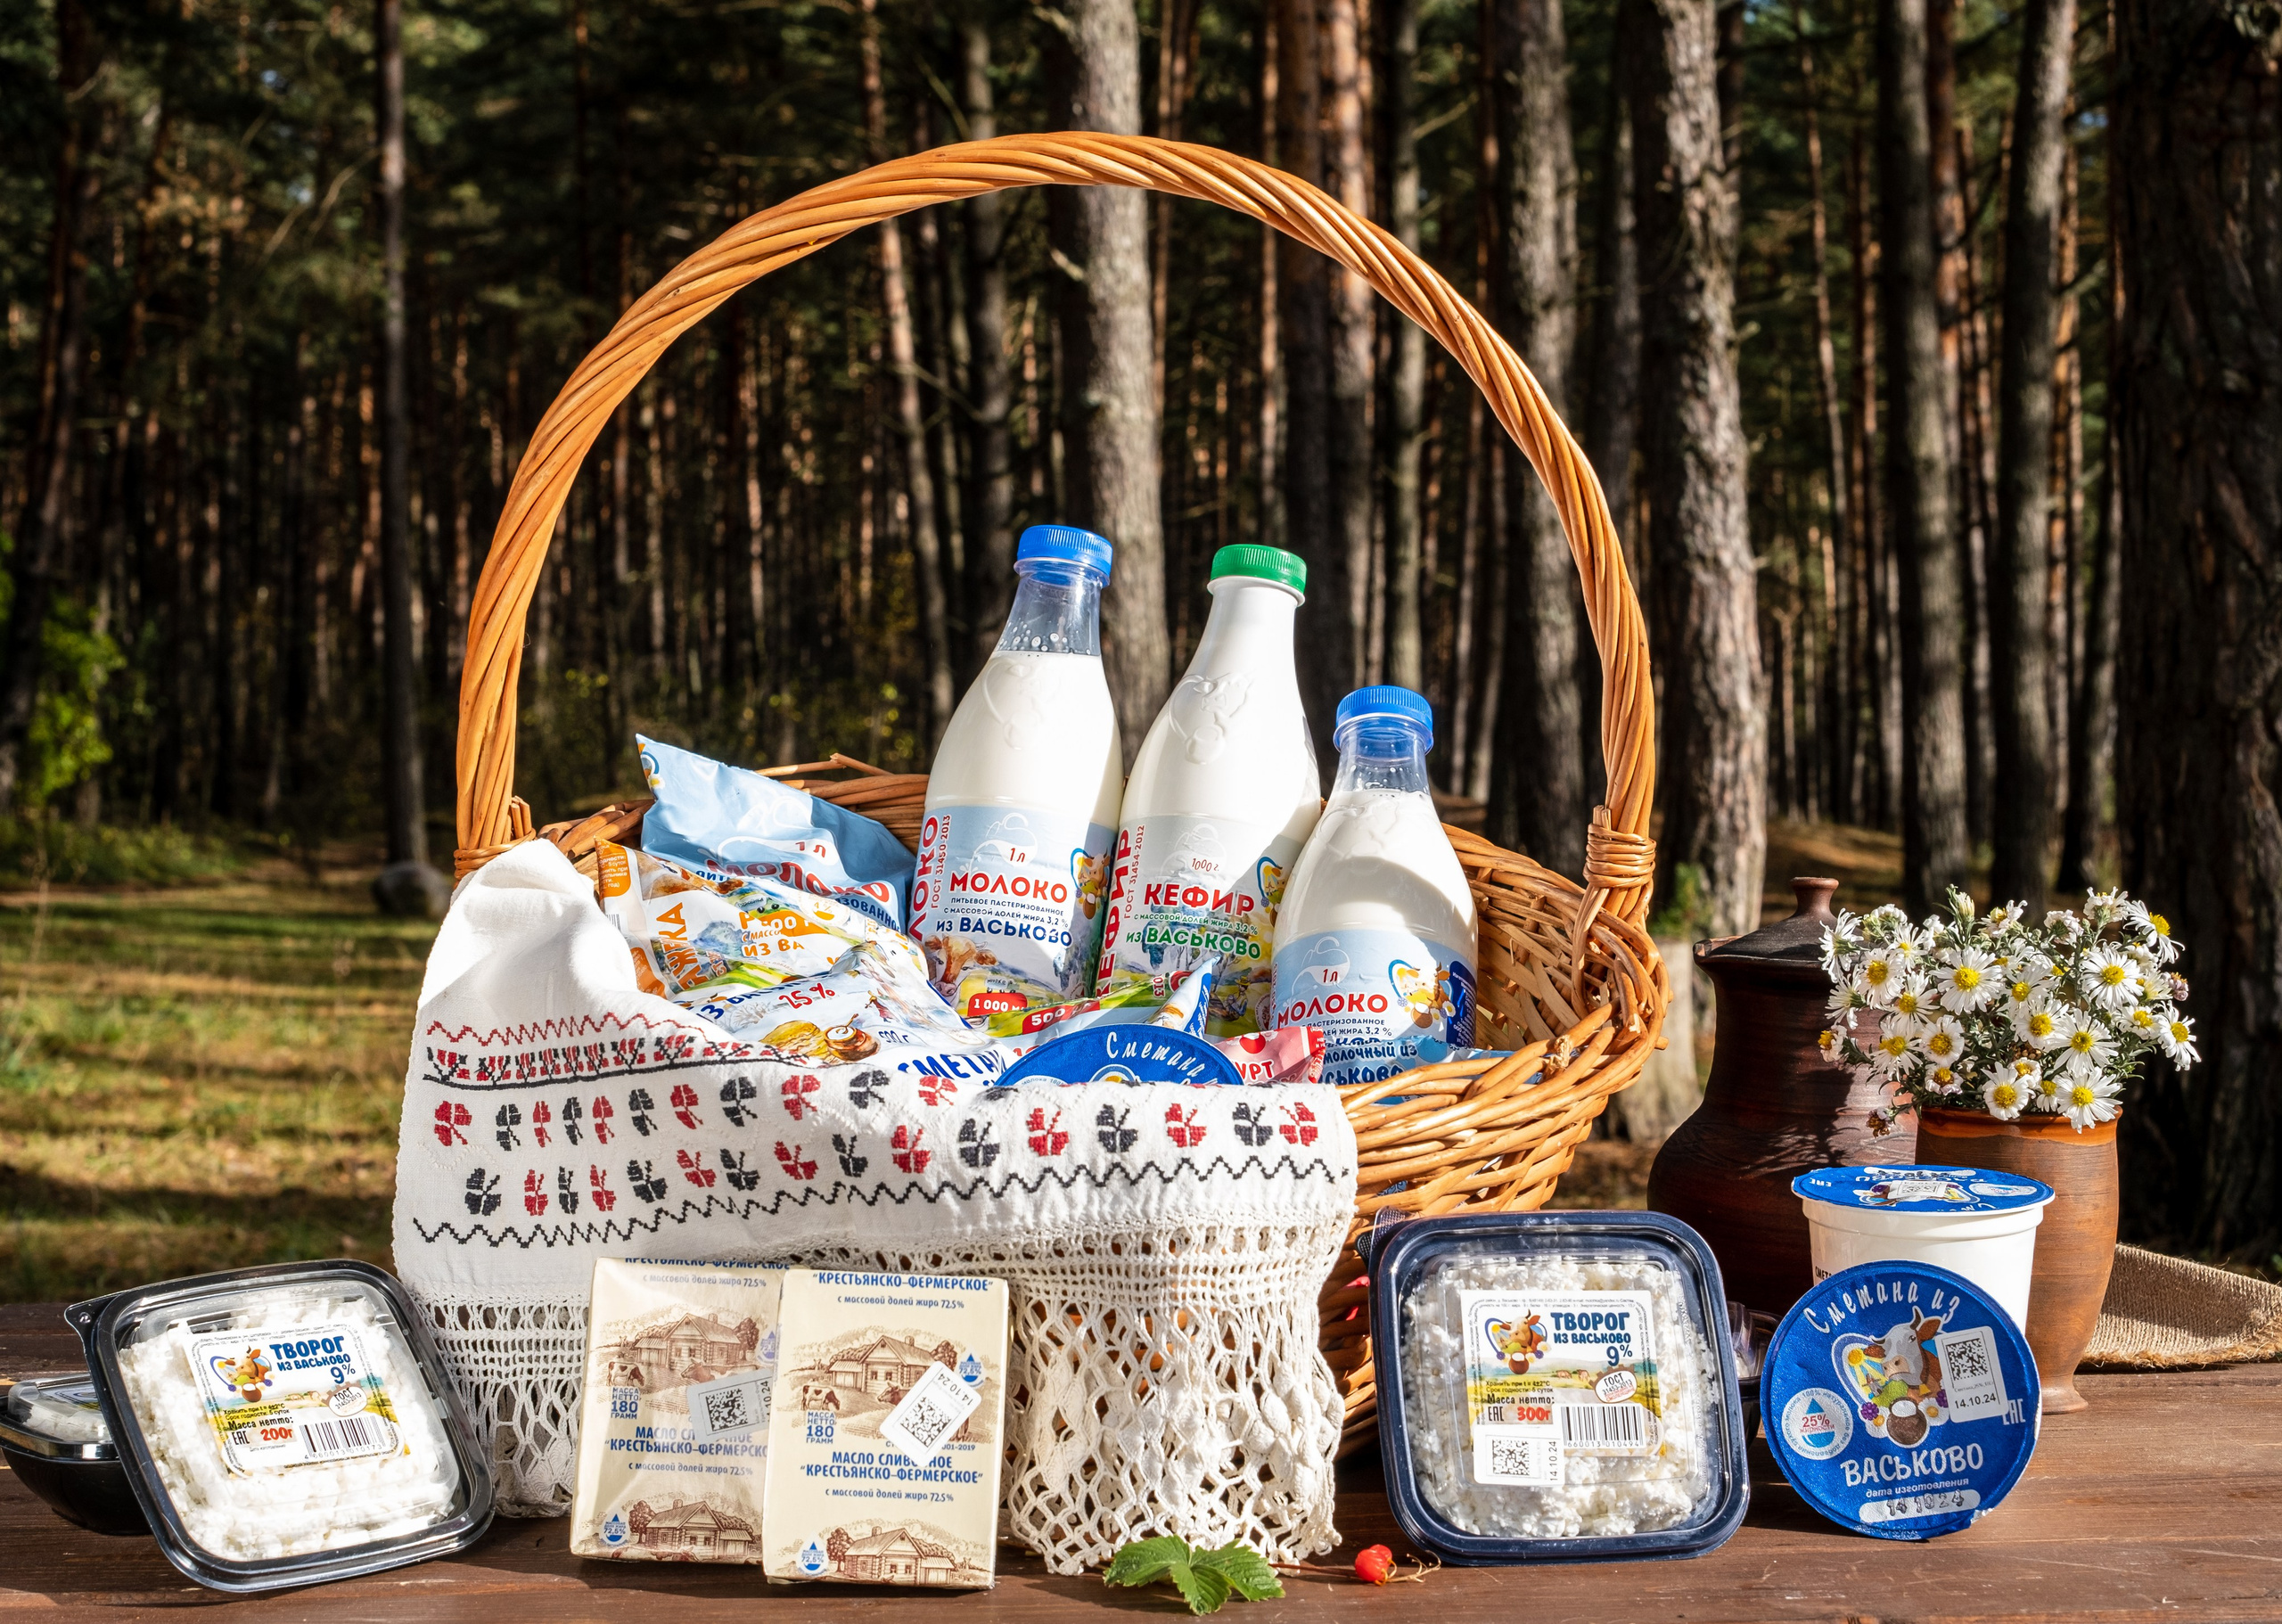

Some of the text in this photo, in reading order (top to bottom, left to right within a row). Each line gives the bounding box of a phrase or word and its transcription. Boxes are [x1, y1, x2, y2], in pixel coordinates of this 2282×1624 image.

[932, 815, 952, 909] ГОСТ 31450-2013
[1009, 848, 1027, 864] 1 л
[1124, 824, 1145, 919] ГОСТ 31454-2012
[1191, 857, 1212, 872] 1000
[949, 872, 1068, 904] МОЛОКО
[950, 897, 1064, 916] ПИТЬЕВОЕ ПАСТЕРИЗОВАННОЕ
[1144, 883, 1255, 918] КЕФИР
[949, 907, 994, 916] МАССОВОЙ
[994, 907, 1022, 919] ДОЛЕЙ
[1022, 915, 1046, 923] ЖИРА
[1047, 916, 1060, 926] 3,2
[1139, 914, 1180, 922] МАССОВОЙ
[1181, 915, 1209, 925] ДОЛЕЙ
[1211, 919, 1234, 930] ЖИРА
[1235, 922, 1248, 933] 3,2
[936, 917, 1073, 947] ИЗ ВАСЬКОВО
[1126, 927, 1261, 960] ИЗ ВАСЬКОВО
[1322, 968, 1339, 983] 1 л
[1031, 1007, 1065, 1026] 500
[1277, 994, 1389, 1028] МОЛОКО
[1339, 1028, 1363, 1036] ЖИРА
[1106, 1030, 1206, 1078] Сметана
[844, 1295, 886, 1305] массовой
[887, 1295, 914, 1306] долей
[915, 1298, 939, 1308] жира
[1803, 1281, 1960, 1333] Сметана из
[1550, 1312, 1630, 1332] ТВОРОГ
[1553, 1333, 1631, 1344] ИЗ ВАСЬКОВО
[269, 1336, 345, 1360] ТВОРОГ
[277, 1353, 351, 1372] ИЗ ВАСЬКОВО
[1603, 1372, 1624, 1388] ГОСТ
[334, 1386, 353, 1401] ГОСТ
[612, 1387, 640, 1395] МАССА
[1487, 1393, 1555, 1405] Масса нетто:
[611, 1400, 638, 1414] 180
[1954, 1392, 1997, 1409] 14.10.24
[610, 1412, 637, 1420] ГРАММ
[808, 1411, 835, 1419] МАССА
[1517, 1406, 1551, 1422] 300г
[1802, 1414, 1830, 1428] 25%
[227, 1416, 293, 1431] Масса нетто:
[806, 1425, 834, 1438] 180
[260, 1426, 293, 1441] 200г
[636, 1426, 677, 1441] МАСЛО
[806, 1437, 833, 1445] ГРАММ
[832, 1451, 874, 1464] МАСЛО
[1548, 1440, 1558, 1480] 14.10.24
[1840, 1442, 1983, 1488] ВАСЬКОВО
[635, 1462, 677, 1472] массовой
[677, 1462, 703, 1473] долей
[705, 1464, 728, 1474] жира
[833, 1489, 874, 1498] массовой
[875, 1489, 902, 1499] долей
[904, 1492, 928, 1502] жира
[1866, 1478, 1969, 1498] дата изготовления
